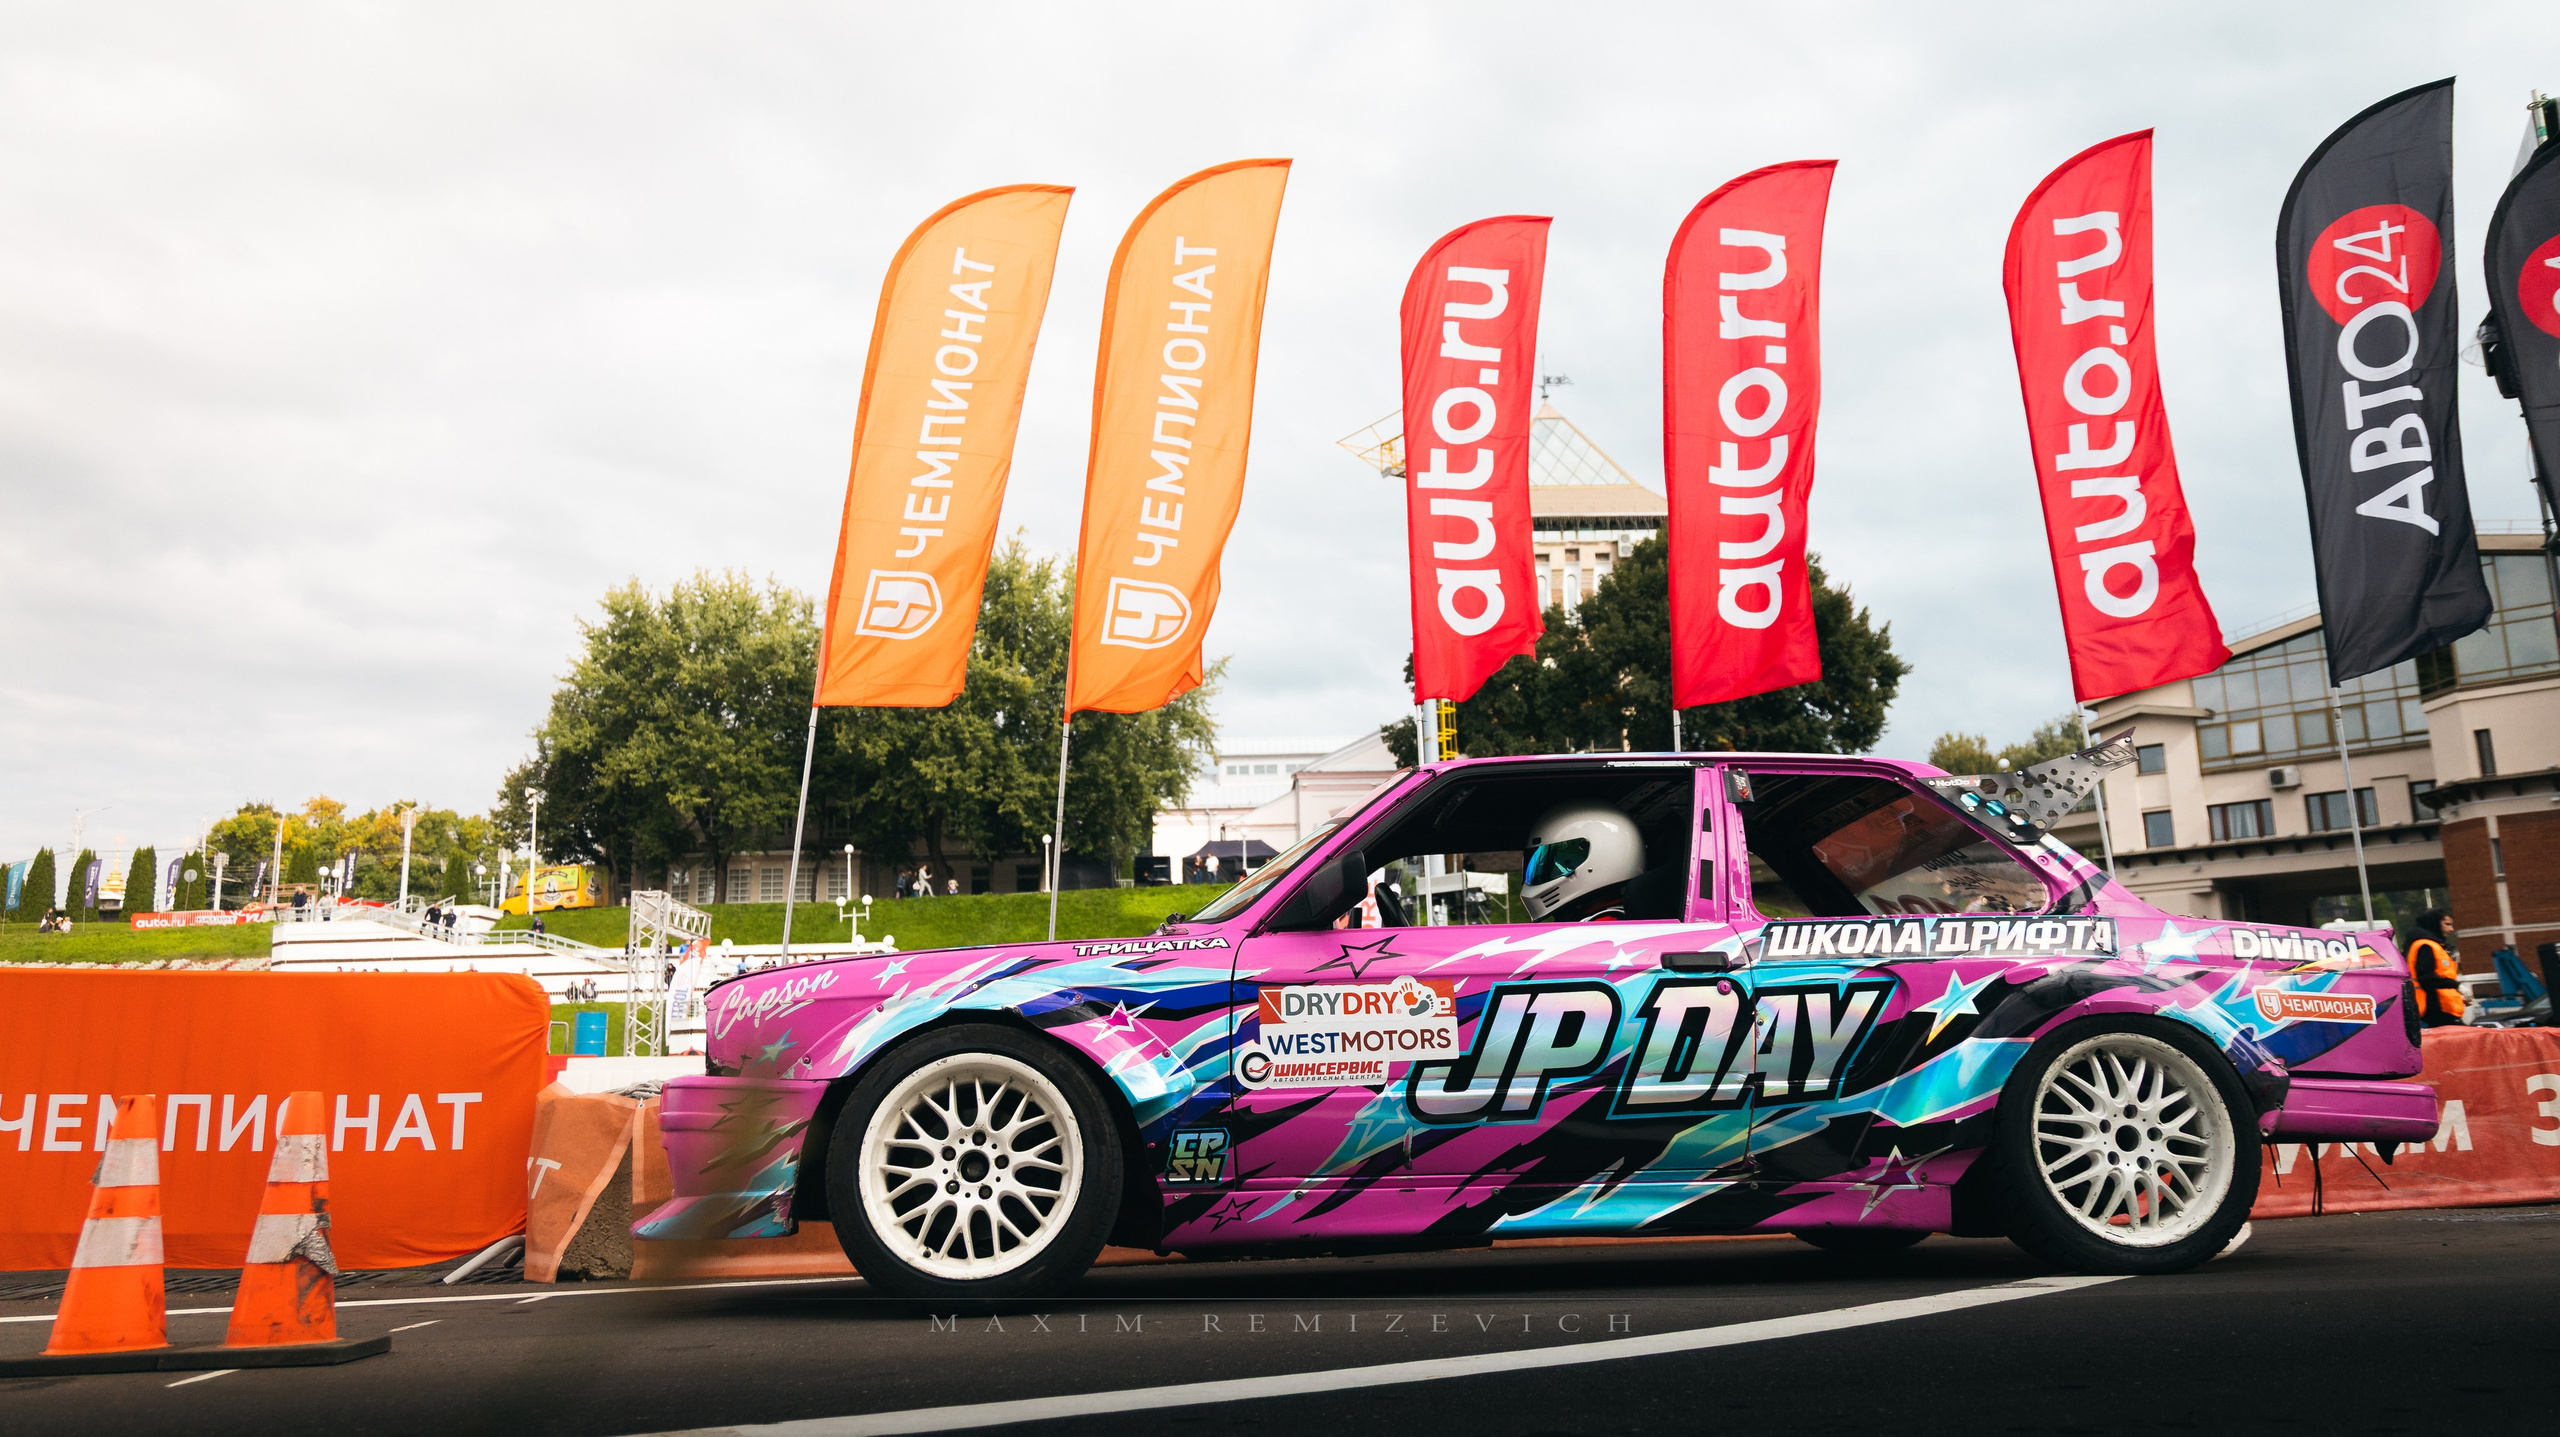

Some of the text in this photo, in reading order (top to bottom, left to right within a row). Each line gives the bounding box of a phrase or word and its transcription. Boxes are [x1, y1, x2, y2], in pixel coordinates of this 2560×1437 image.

[895, 246, 996, 559] ЧЕМПИОНАТ
[1132, 235, 1218, 567] ЧЕМПИОНАТ
[2333, 219, 2439, 537] АВТО24
[1709, 227, 1789, 630] auto.ru
[2053, 210, 2160, 619] auto.ru
[1417, 265, 1510, 637] auto.ru
[136, 918, 186, 928] auto.ru
[1073, 937, 1231, 957] ТРИЦАТКА
[1767, 919, 2114, 957] ШКОЛА ДРИФТА
[2230, 928, 2361, 963] Divinol
[714, 968, 840, 1040] Capson
[1284, 991, 1399, 1016] DRYDRY
[2282, 998, 2371, 1015] ЧЕМПИОНАТ
[1267, 1027, 1452, 1056] WESTMOTORS
[1412, 982, 1879, 1117] JP DAY
[1273, 1073, 1383, 1083] АВТОСЕРВИСНЫЕ ЦЕНТРЫ
[1274, 1060, 1384, 1077] ШИНСЕРВИС
[0, 1092, 482, 1152] ЧЕПИНАТ
